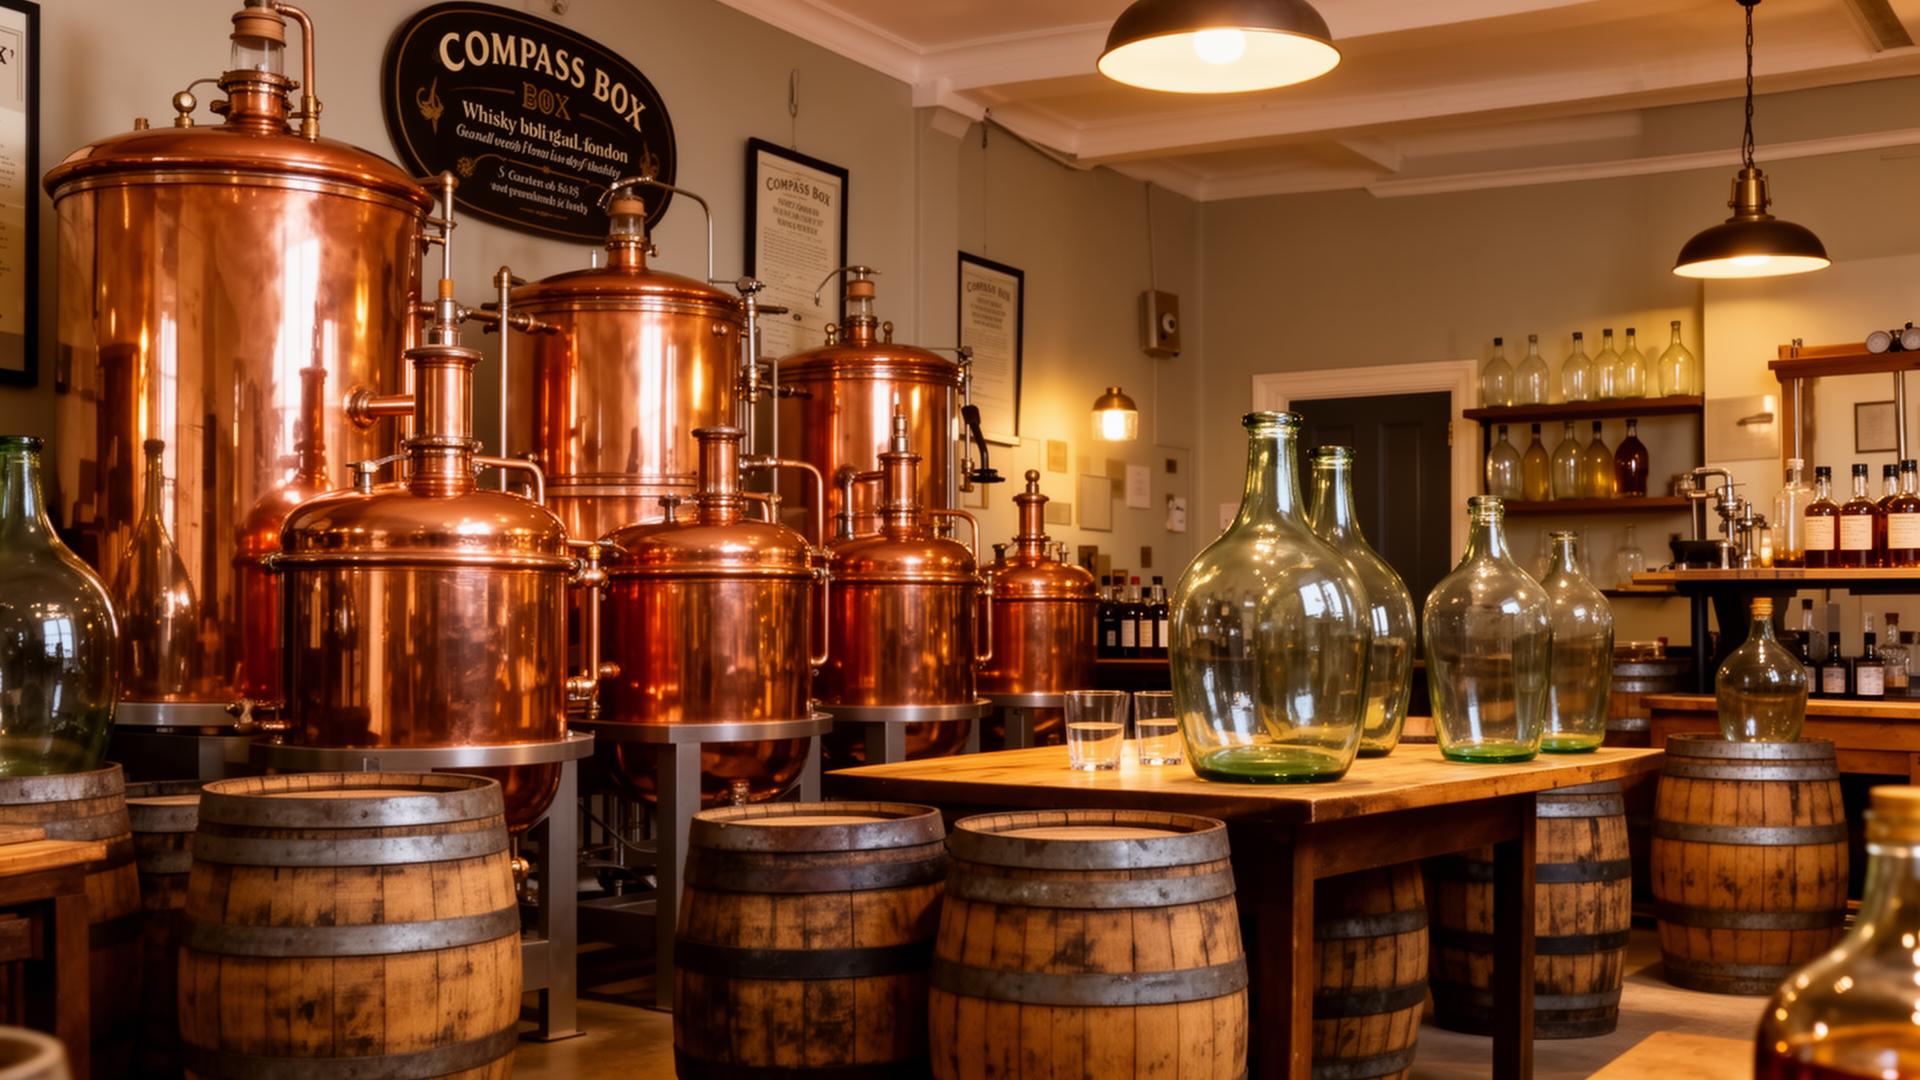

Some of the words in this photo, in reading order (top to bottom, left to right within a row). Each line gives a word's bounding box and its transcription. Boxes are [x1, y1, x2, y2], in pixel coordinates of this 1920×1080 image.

[439, 30, 586, 88] COMPASS
[592, 68, 647, 133] BOX
[462, 100, 518, 136] Whisky
[522, 81, 572, 121] BOX
[766, 176, 810, 196] COMPASS
[812, 186, 832, 207] BOX
